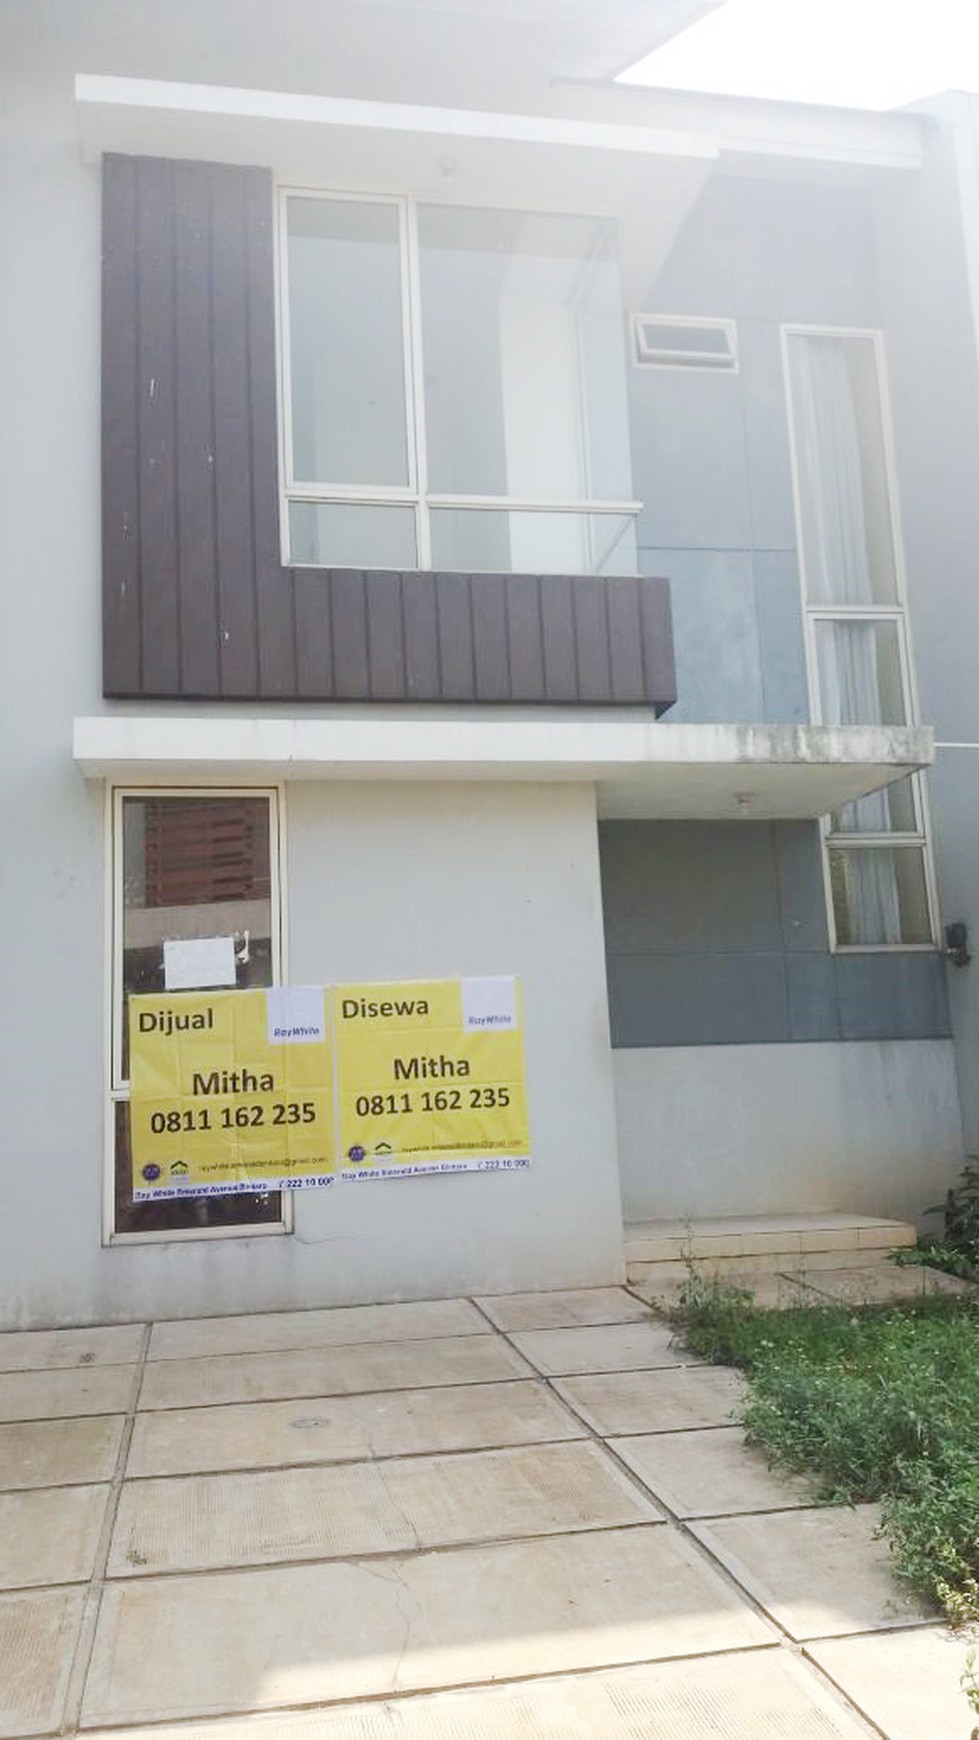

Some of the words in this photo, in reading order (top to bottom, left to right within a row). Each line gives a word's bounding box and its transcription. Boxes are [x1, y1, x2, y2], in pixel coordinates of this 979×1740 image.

[139, 1008, 213, 1036] Dijual
[342, 998, 429, 1019] Disewa
[394, 1055, 470, 1080] Mitha
[193, 1069, 274, 1096] Mitha
[356, 1093, 413, 1117] 0811
[421, 1090, 462, 1112] 162
[469, 1087, 510, 1109] 235
[151, 1109, 211, 1134] 0811
[221, 1105, 264, 1129] 162
[272, 1102, 316, 1125] 235
